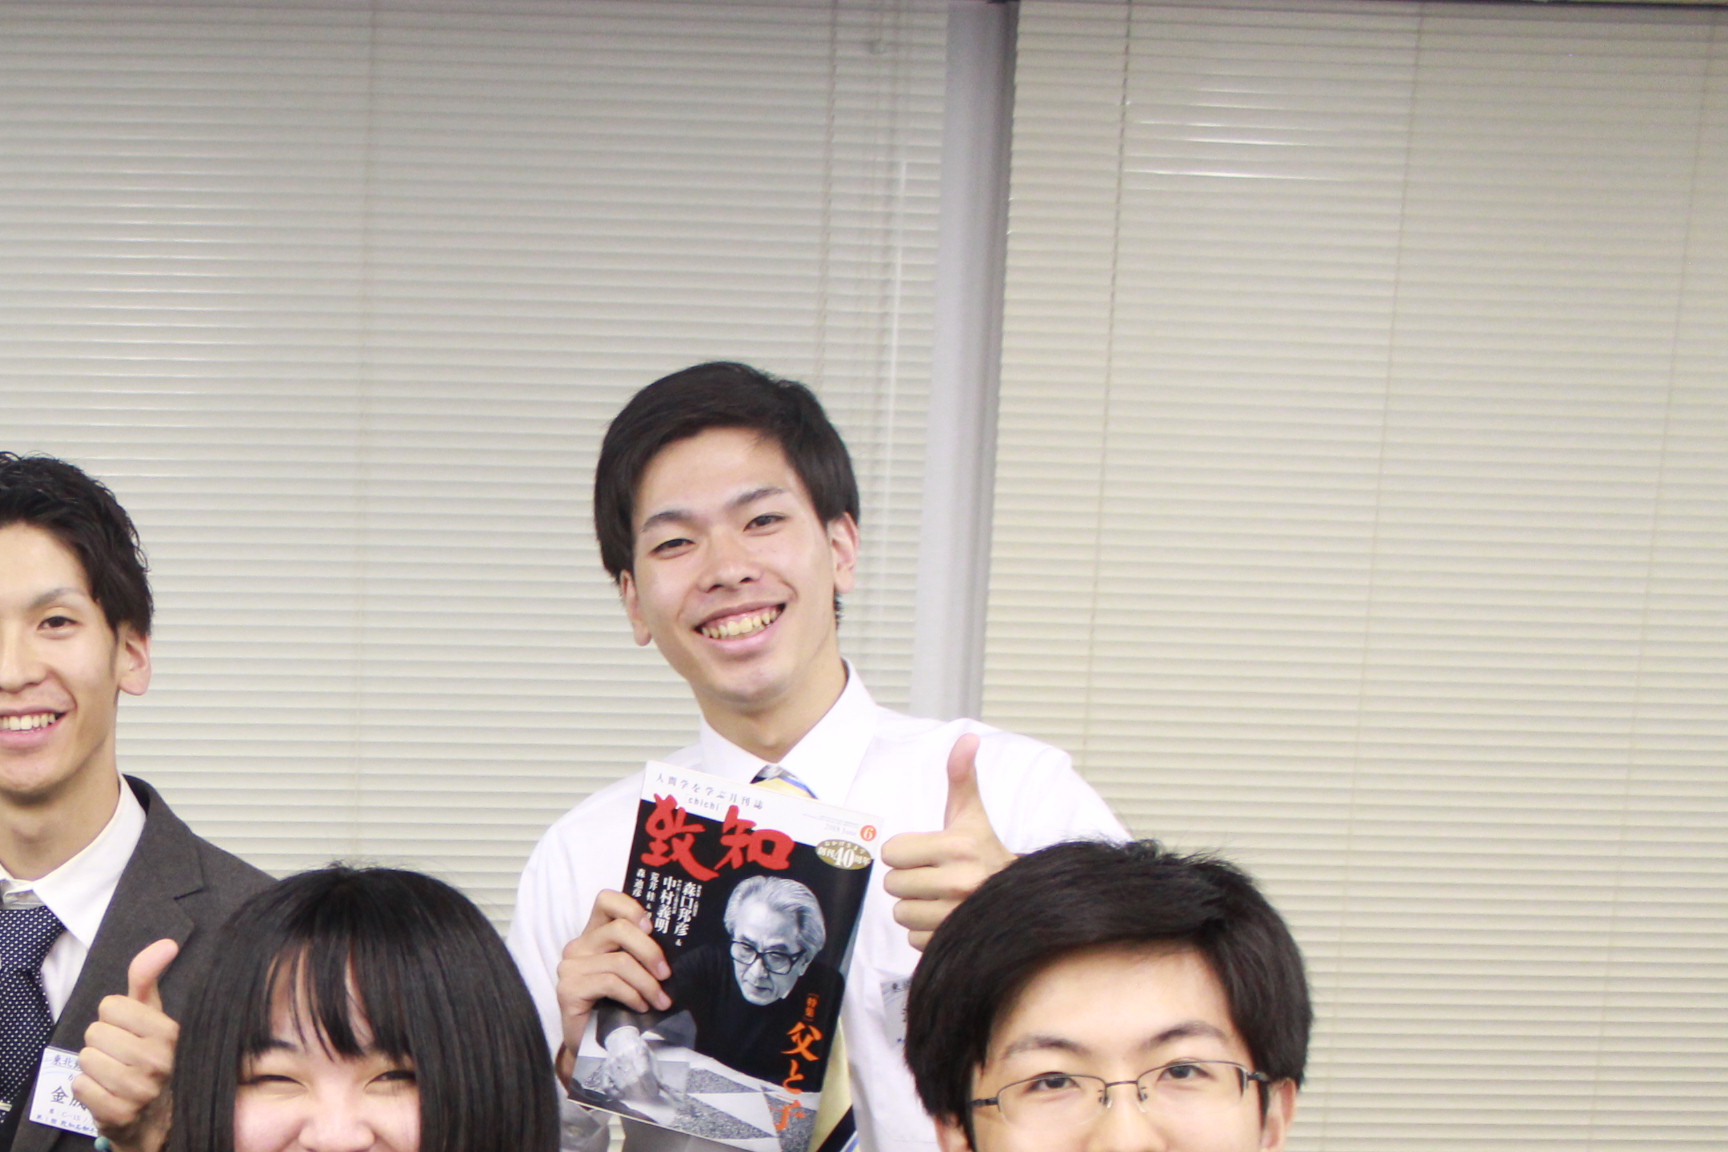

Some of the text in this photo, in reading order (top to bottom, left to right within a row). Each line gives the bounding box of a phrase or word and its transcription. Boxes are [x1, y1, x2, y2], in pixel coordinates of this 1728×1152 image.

[657, 773, 763, 809] 人間学を学ぶ月刊誌
[688, 797, 720, 811] chichi
[641, 793, 795, 881] 致知
[863, 827, 874, 840] 6
[654, 876, 677, 934] 中村義明
[674, 882, 697, 936] 森口邦彦
[768, 1022, 823, 1131] 父と子
